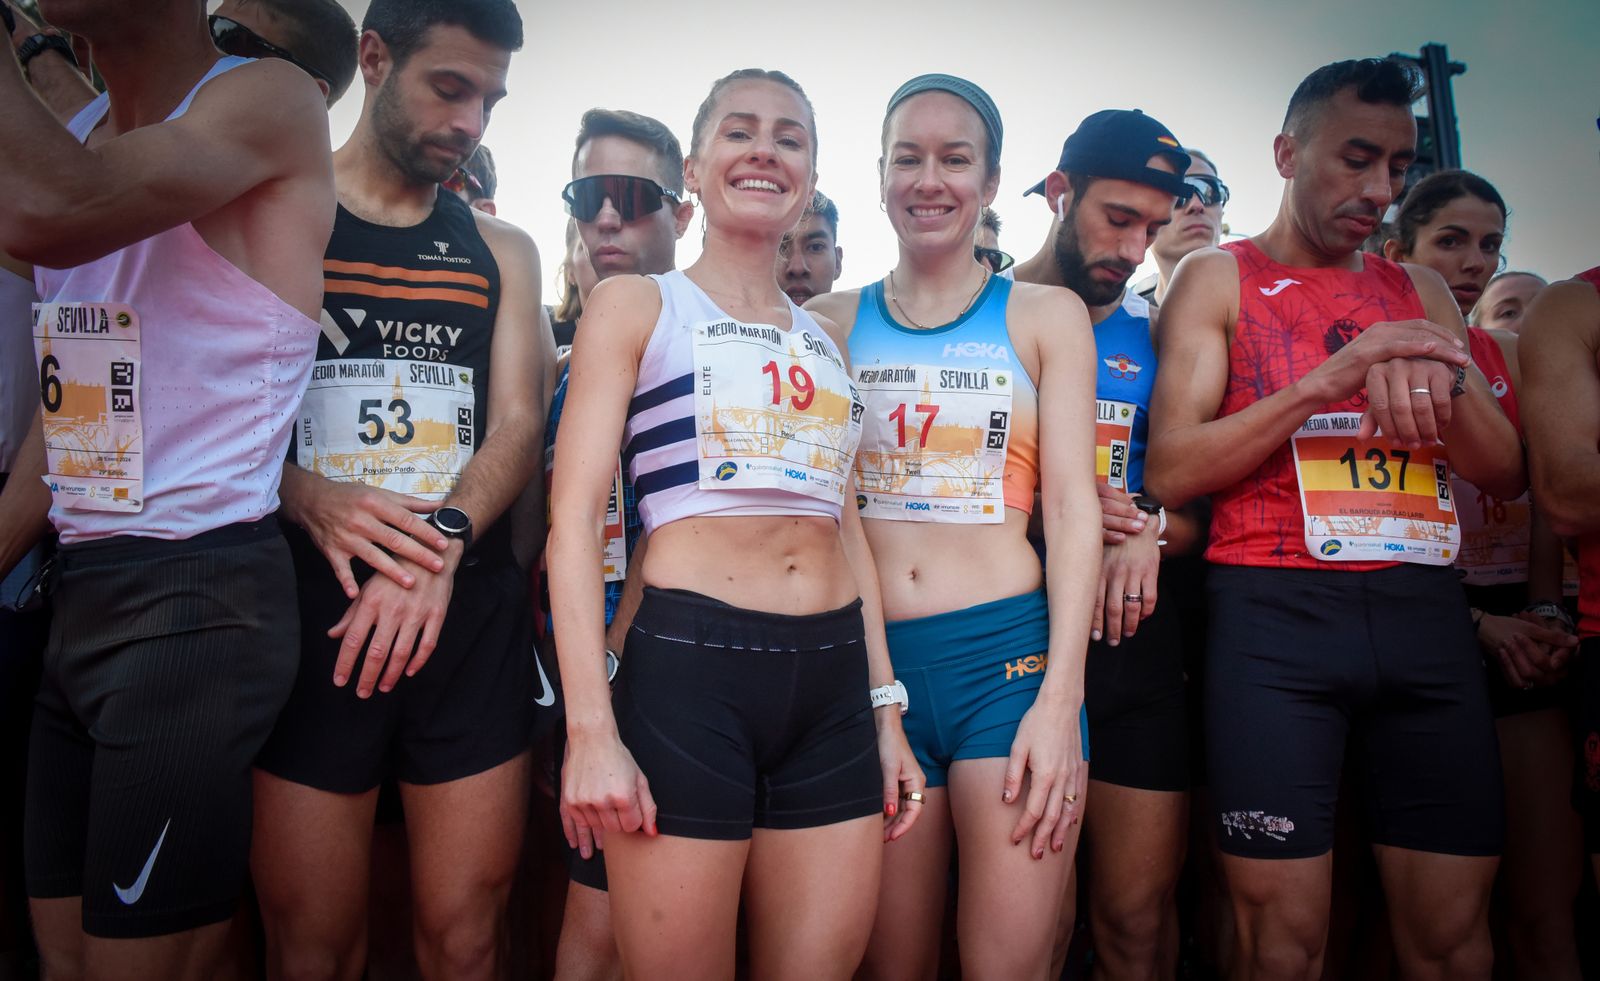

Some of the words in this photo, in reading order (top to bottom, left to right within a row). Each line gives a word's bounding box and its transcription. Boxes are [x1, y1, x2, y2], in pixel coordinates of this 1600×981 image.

[443, 256, 471, 265] POSTIGO
[57, 306, 110, 334] SEVILLA
[375, 319, 463, 347] VICKY
[707, 322, 737, 338] MEDIO
[739, 327, 782, 346] MARATÓN
[383, 344, 449, 361] FOODS
[942, 342, 1010, 363] HOKA
[339, 362, 385, 379] MARATÓN
[410, 364, 456, 387] SEVILLA
[703, 365, 711, 396] ELITE
[762, 360, 815, 411] 19
[939, 370, 989, 390] SEVILLA
[304, 417, 313, 447] ELITE
[357, 398, 415, 446] 53
[888, 403, 940, 448] 17
[1330, 417, 1361, 430] MARAT
[784, 468, 807, 481] HOKA
[1339, 447, 1411, 491] 137
[905, 502, 930, 511] HOKA
[1384, 542, 1406, 552] HOKA
[1005, 654, 1049, 680] HOK
